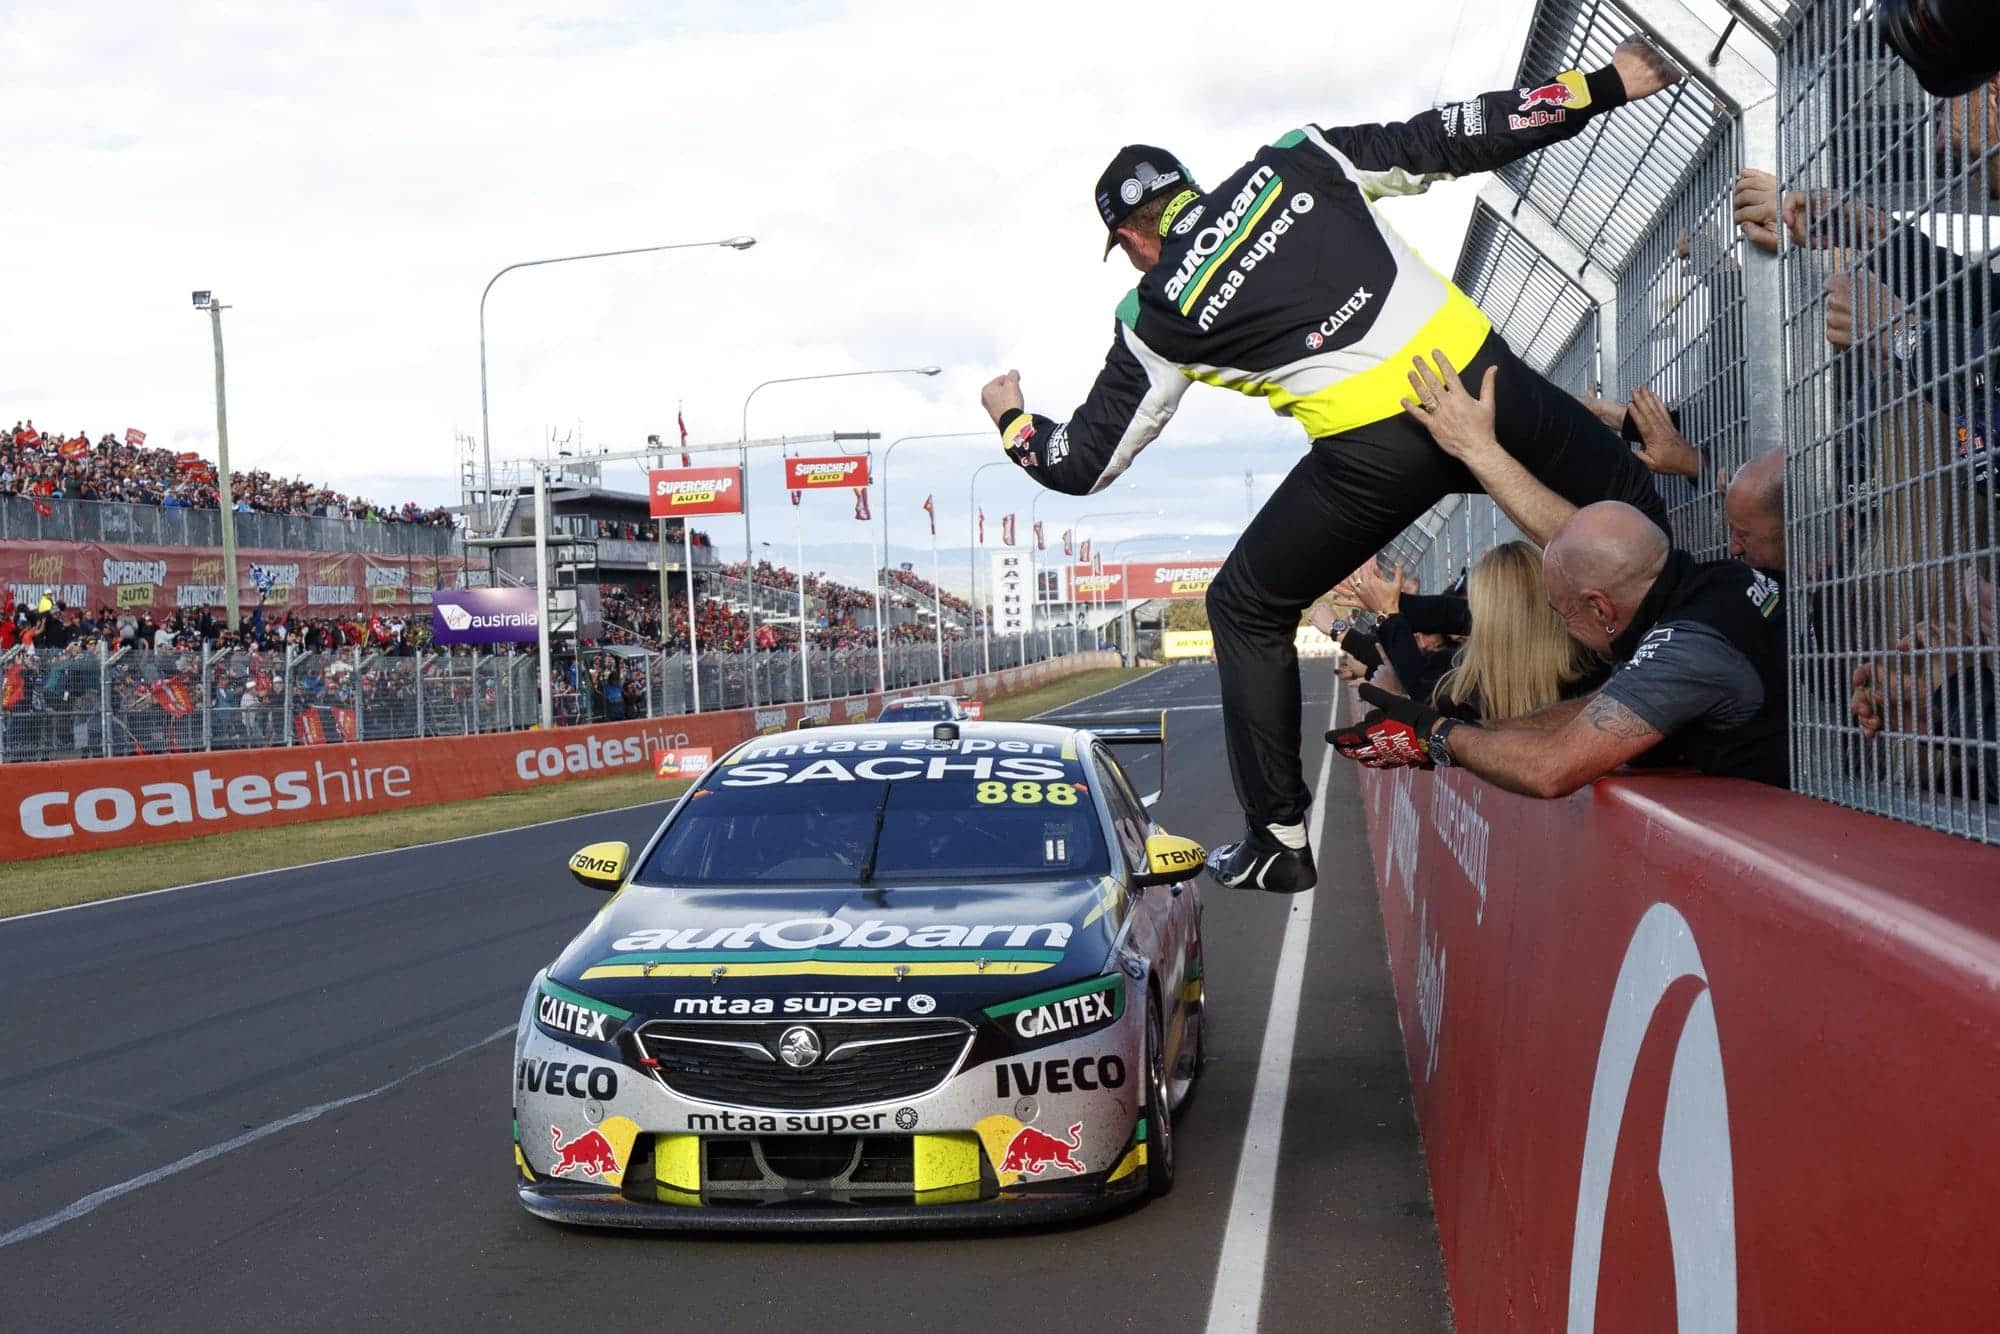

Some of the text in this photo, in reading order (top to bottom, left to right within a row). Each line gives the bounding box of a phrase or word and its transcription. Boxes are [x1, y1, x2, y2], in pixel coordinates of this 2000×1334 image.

[1198, 209, 1295, 332] mtaa super
[1320, 286, 1373, 337] CALTEX
[795, 461, 858, 476] SUPERCHEAP
[811, 472, 841, 482] AUTO
[656, 477, 733, 497] SUPERCHEAP
[676, 492, 710, 503] AUTO
[103, 558, 167, 587] SUPERCHEAP
[121, 587, 149, 601] AUTO
[472, 611, 538, 628] australia
[747, 738, 888, 759] mtaa
[721, 756, 1065, 786] SACHS
[976, 781, 1078, 806] 888
[539, 996, 608, 1042] CALTEX
[673, 996, 902, 1017] mtaa super
[1015, 991, 1114, 1038] CALTEX
[518, 1057, 618, 1101] IVECO
[995, 1055, 1126, 1098] IVECO
[687, 1110, 887, 1136] mtaa super
